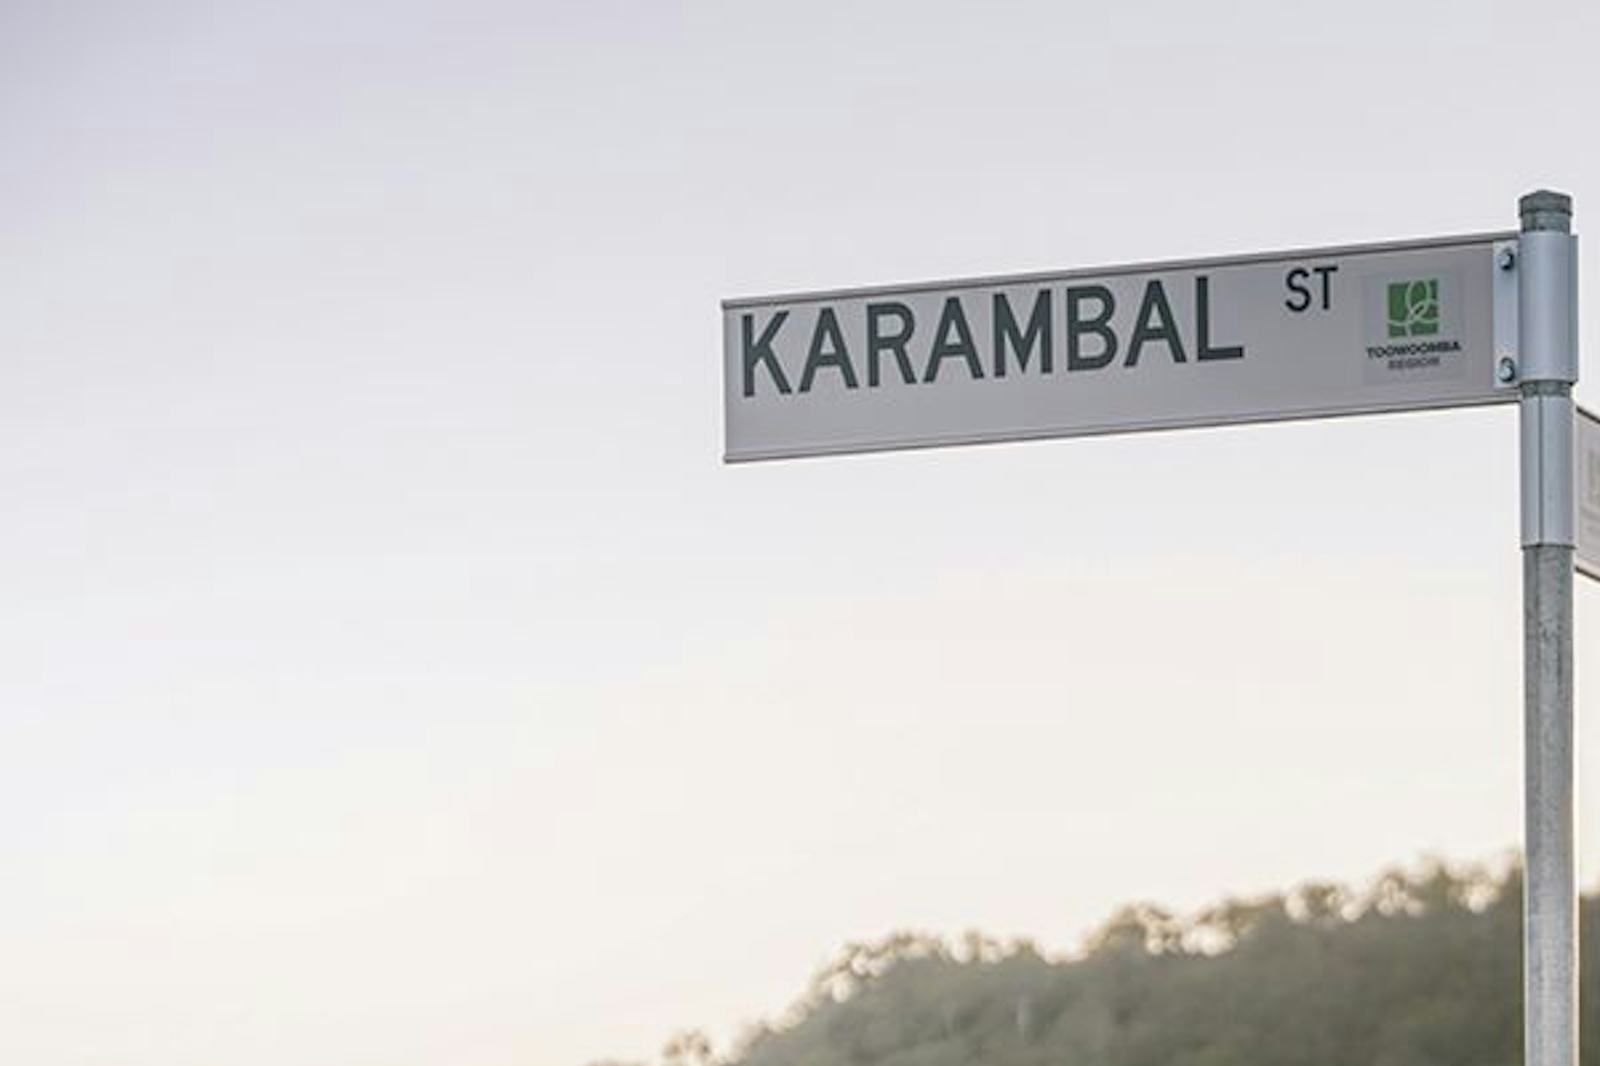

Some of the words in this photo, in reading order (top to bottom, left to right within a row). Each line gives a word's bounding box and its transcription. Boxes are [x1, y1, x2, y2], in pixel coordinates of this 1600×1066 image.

[741, 275, 1244, 397] KARAMBAL
[1284, 265, 1339, 313] ST
[1366, 341, 1462, 359] TOOWOOMBA
